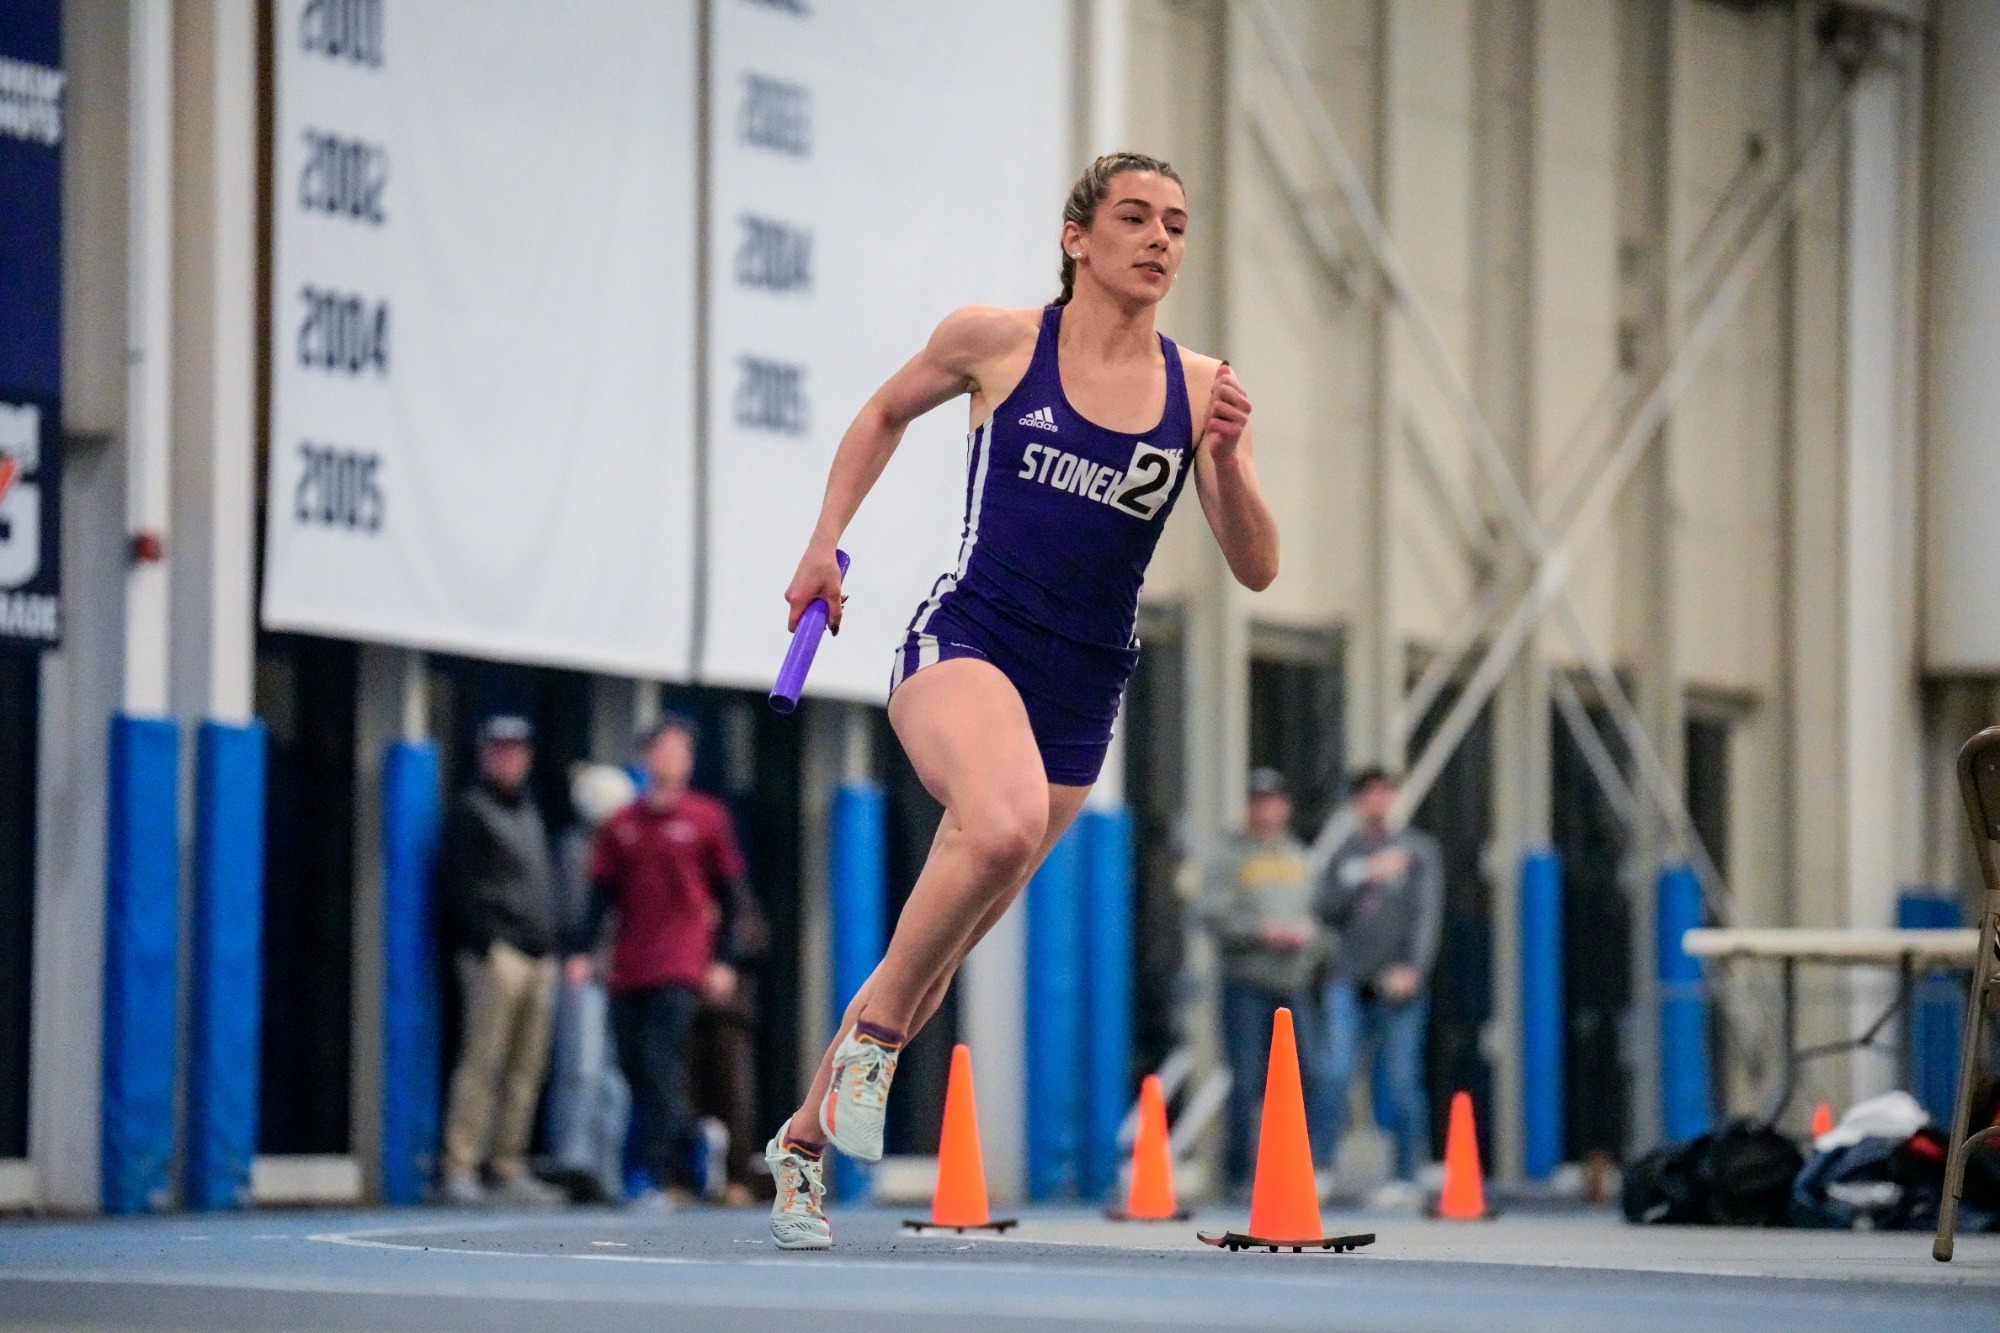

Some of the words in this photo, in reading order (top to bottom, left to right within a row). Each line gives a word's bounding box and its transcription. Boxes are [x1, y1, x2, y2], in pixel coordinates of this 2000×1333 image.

[298, 126, 388, 227] 2002
[295, 282, 391, 379] 2004
[1018, 417, 1059, 433] adidas
[293, 440, 385, 535] 2005
[1116, 452, 1171, 516] 2
